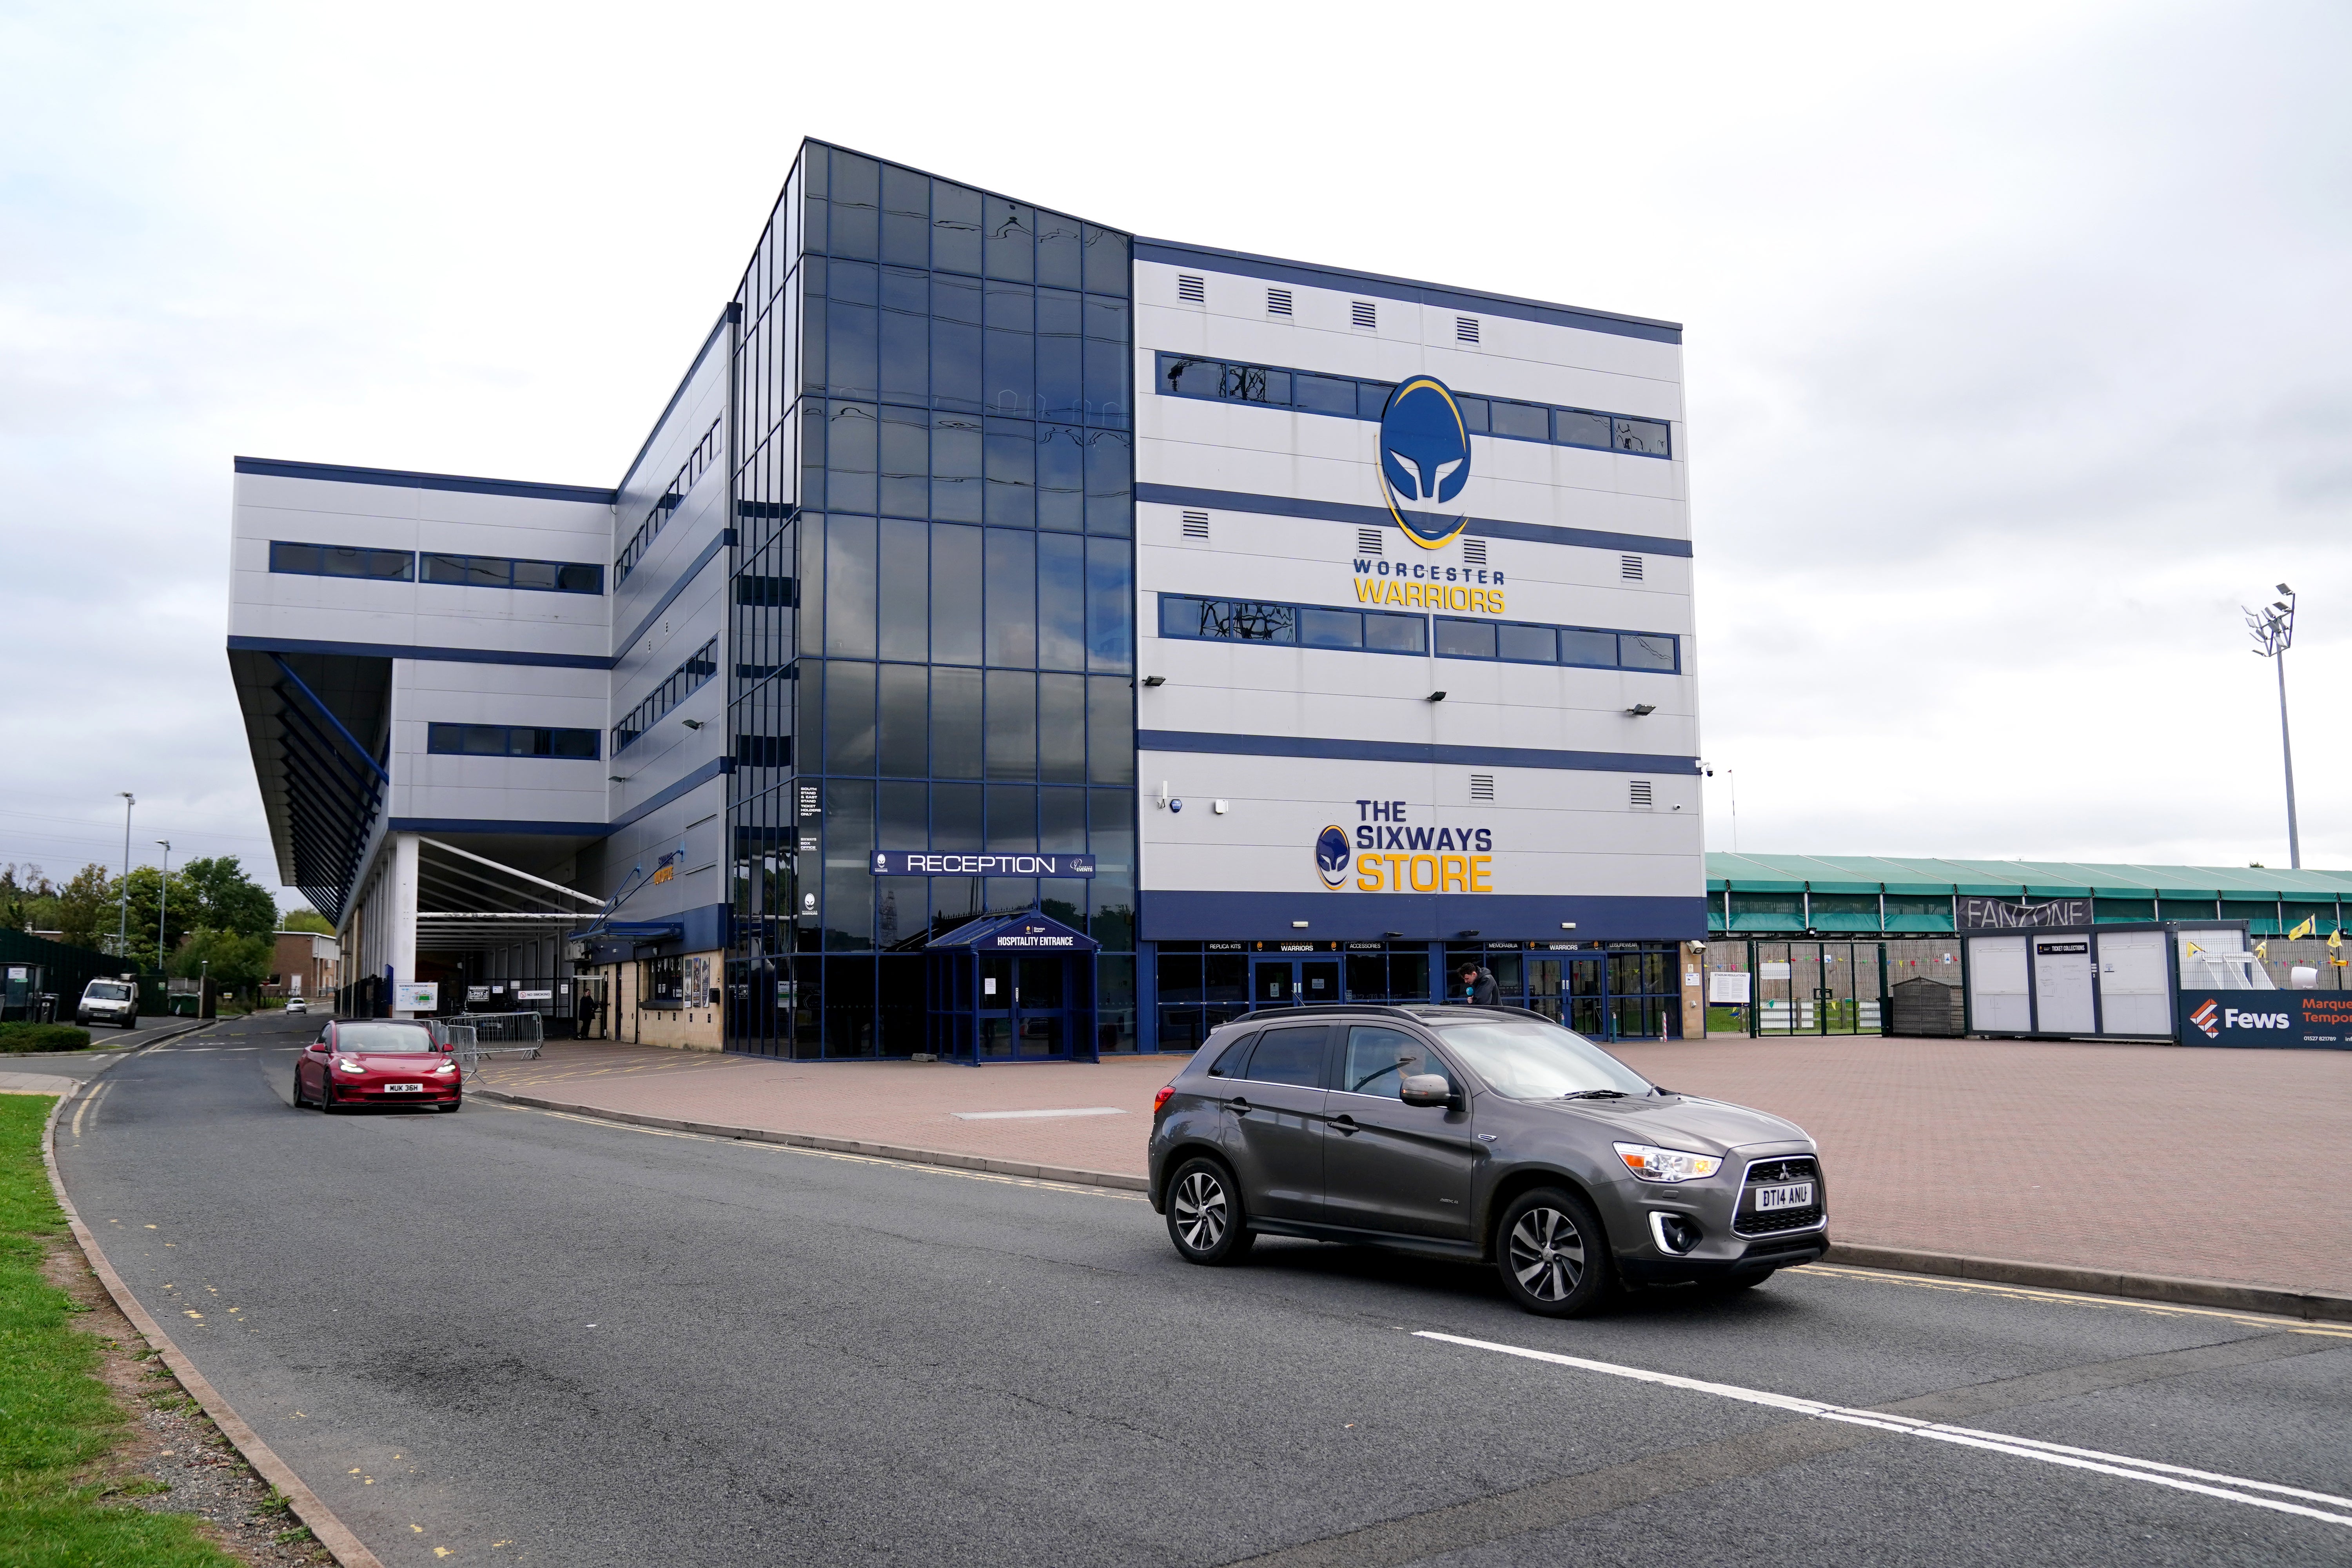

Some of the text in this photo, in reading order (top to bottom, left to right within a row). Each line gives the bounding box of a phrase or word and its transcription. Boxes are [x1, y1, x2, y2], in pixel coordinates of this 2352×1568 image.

[1353, 558, 1504, 585] WORCESTER
[1354, 577, 1505, 613] WARRIORS
[1356, 800, 1406, 822] THE
[1357, 825, 1492, 851] SIXWAYS
[907, 855, 1055, 873] RECEPTION
[1357, 853, 1493, 891] STORE
[998, 936, 1073, 946] HOSPITALITY ENTRANCE
[2225, 1009, 2289, 1029] Fews
[1763, 1186, 1807, 1206] DT14 ANU
